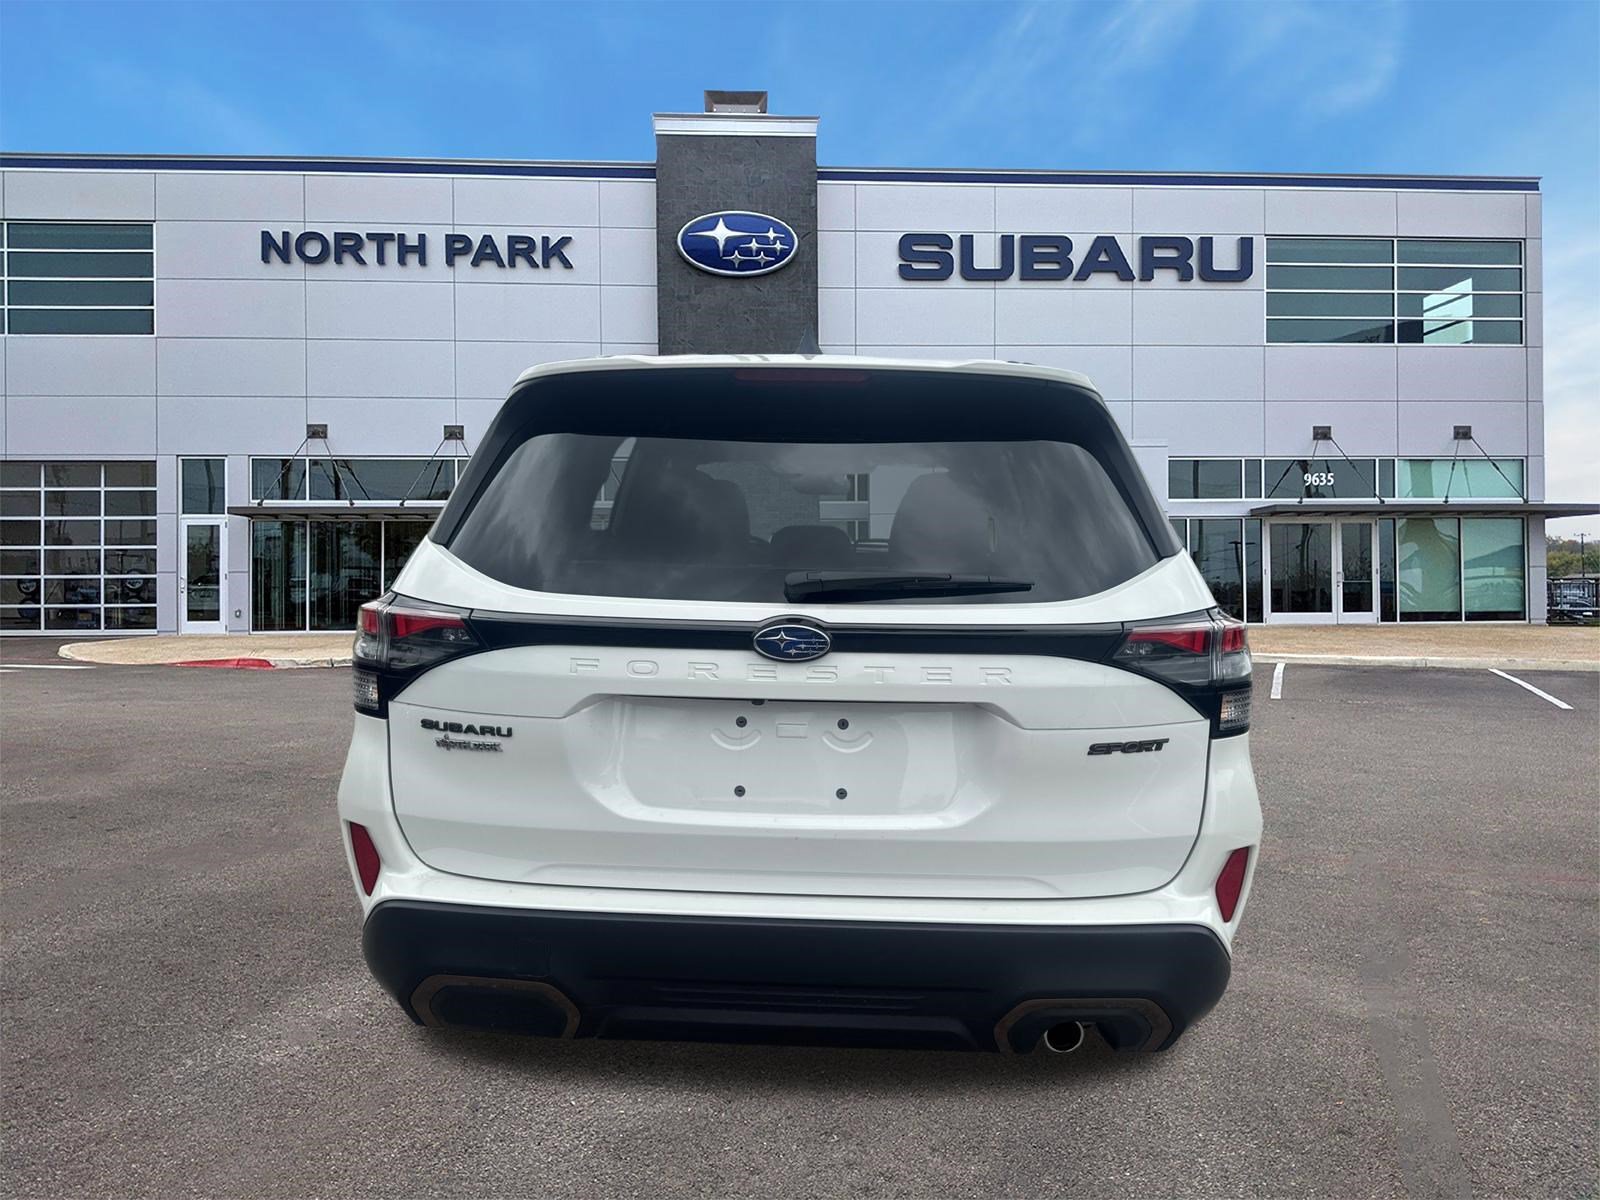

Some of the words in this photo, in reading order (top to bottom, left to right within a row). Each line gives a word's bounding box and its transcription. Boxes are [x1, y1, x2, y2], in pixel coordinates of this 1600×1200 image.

[260, 230, 428, 266] NORTH
[444, 233, 574, 269] PARK
[897, 232, 1255, 282] SUBARU
[1303, 472, 1335, 486] 9635
[569, 656, 1014, 686] FORESTER
[420, 718, 513, 738] SUBARU
[1086, 737, 1170, 756] SPORT
